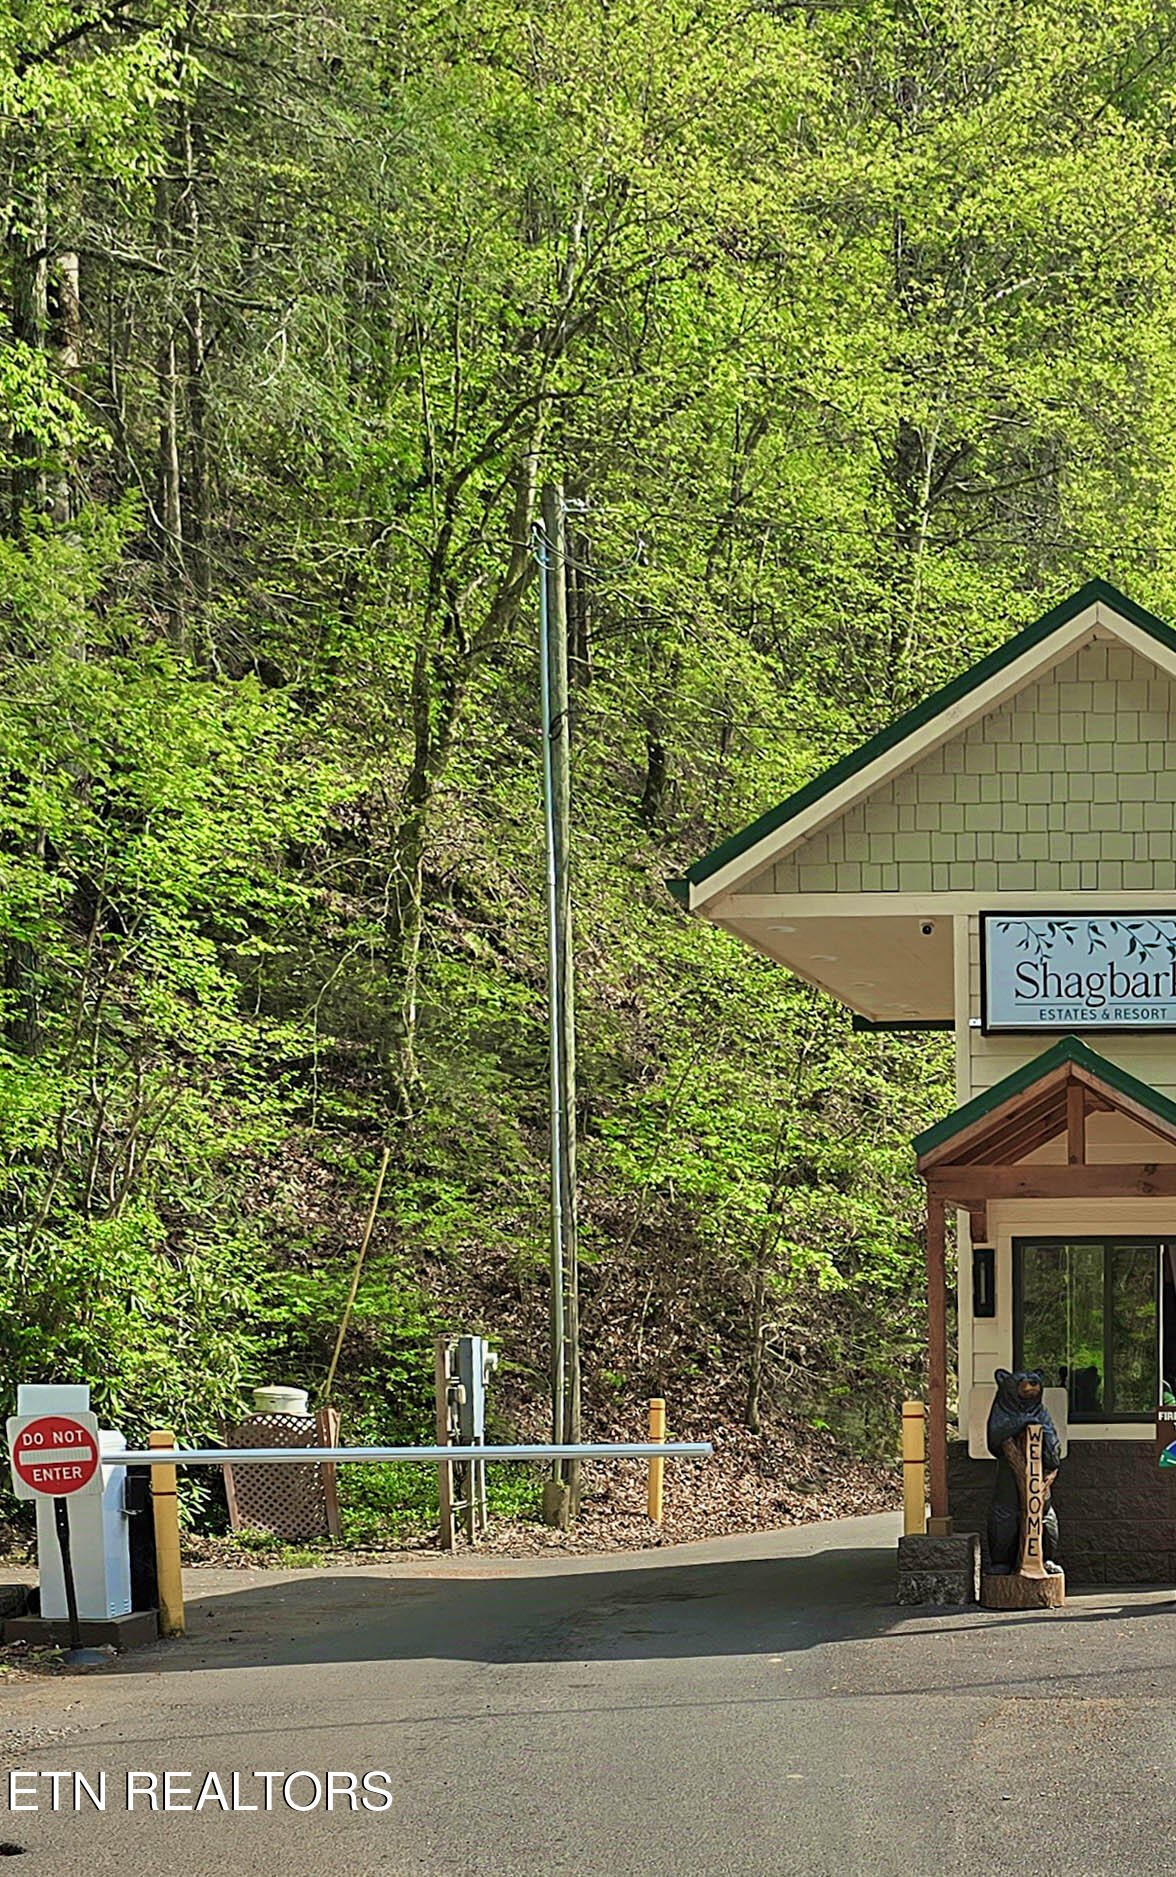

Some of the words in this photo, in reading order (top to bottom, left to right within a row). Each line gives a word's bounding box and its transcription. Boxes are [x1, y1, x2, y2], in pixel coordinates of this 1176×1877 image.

[1039, 1008, 1097, 1020] ESTATES
[1101, 1008, 1110, 1020] &
[1114, 1008, 1168, 1020] RESORT
[22, 1432, 44, 1446] DO
[52, 1430, 84, 1444] NOT
[33, 1466, 82, 1482] ENTER
[1028, 1426, 1042, 1557] WELCOME
